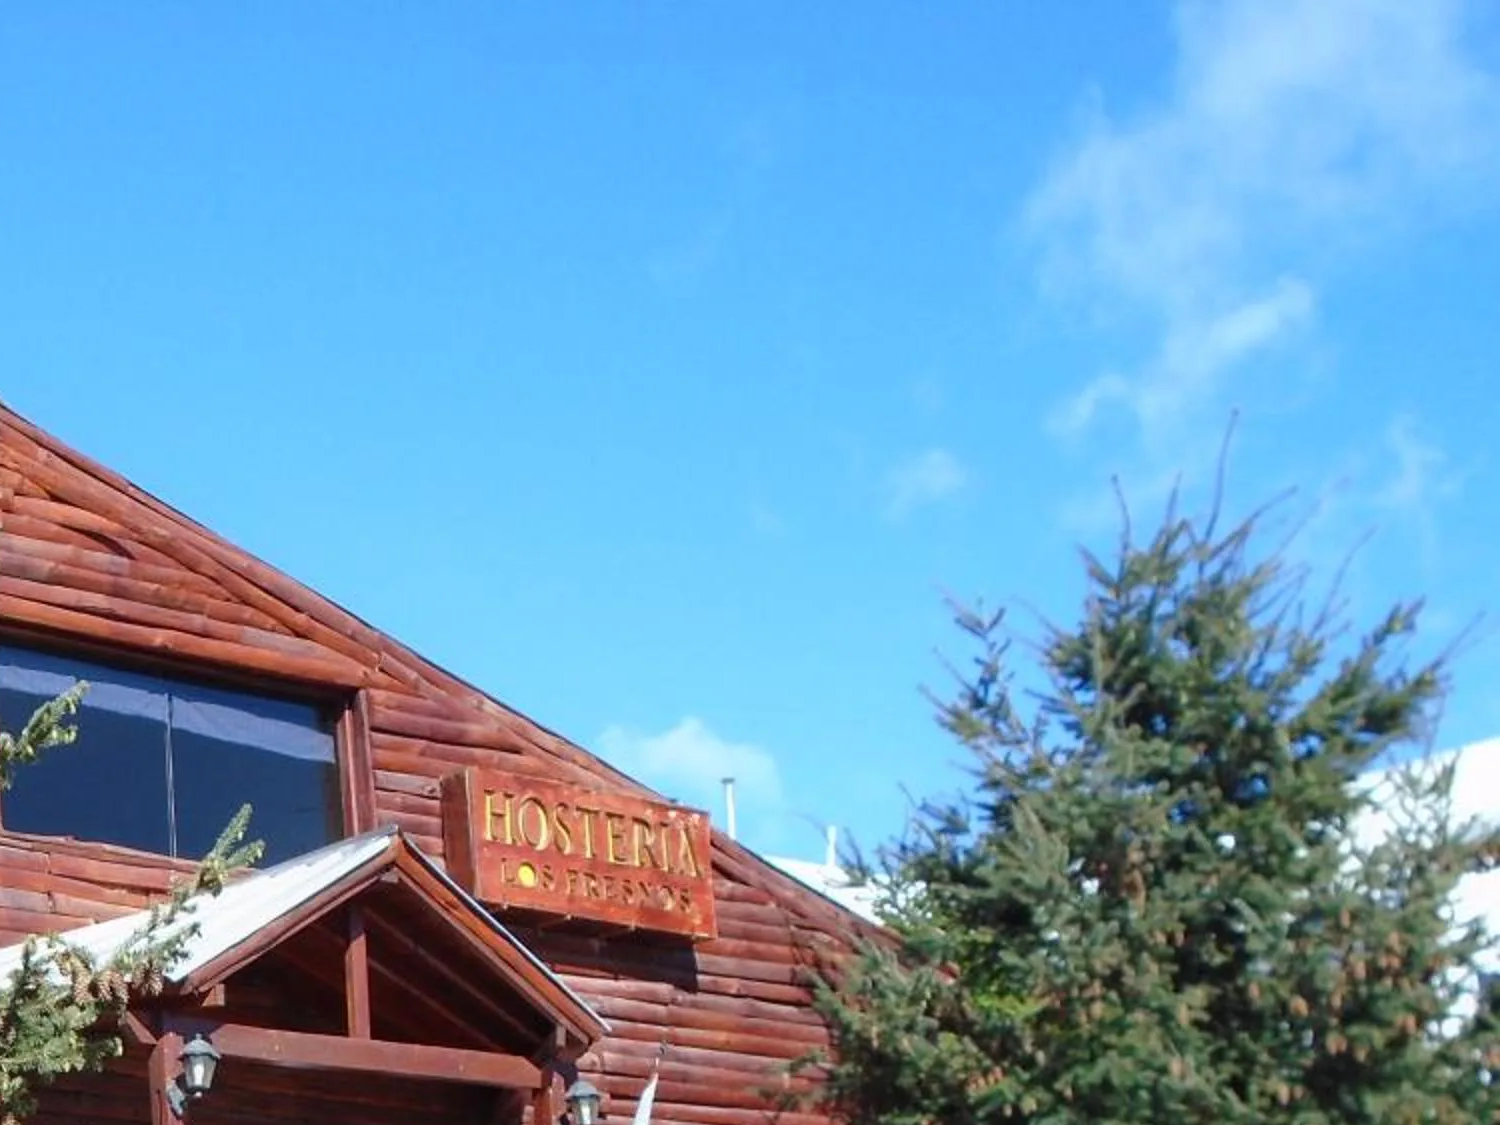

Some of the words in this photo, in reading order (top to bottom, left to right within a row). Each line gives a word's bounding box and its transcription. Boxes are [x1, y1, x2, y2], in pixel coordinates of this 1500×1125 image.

[483, 788, 704, 878] HOSTERIA
[501, 857, 554, 892] LOS
[566, 868, 692, 914] FRESNOS
